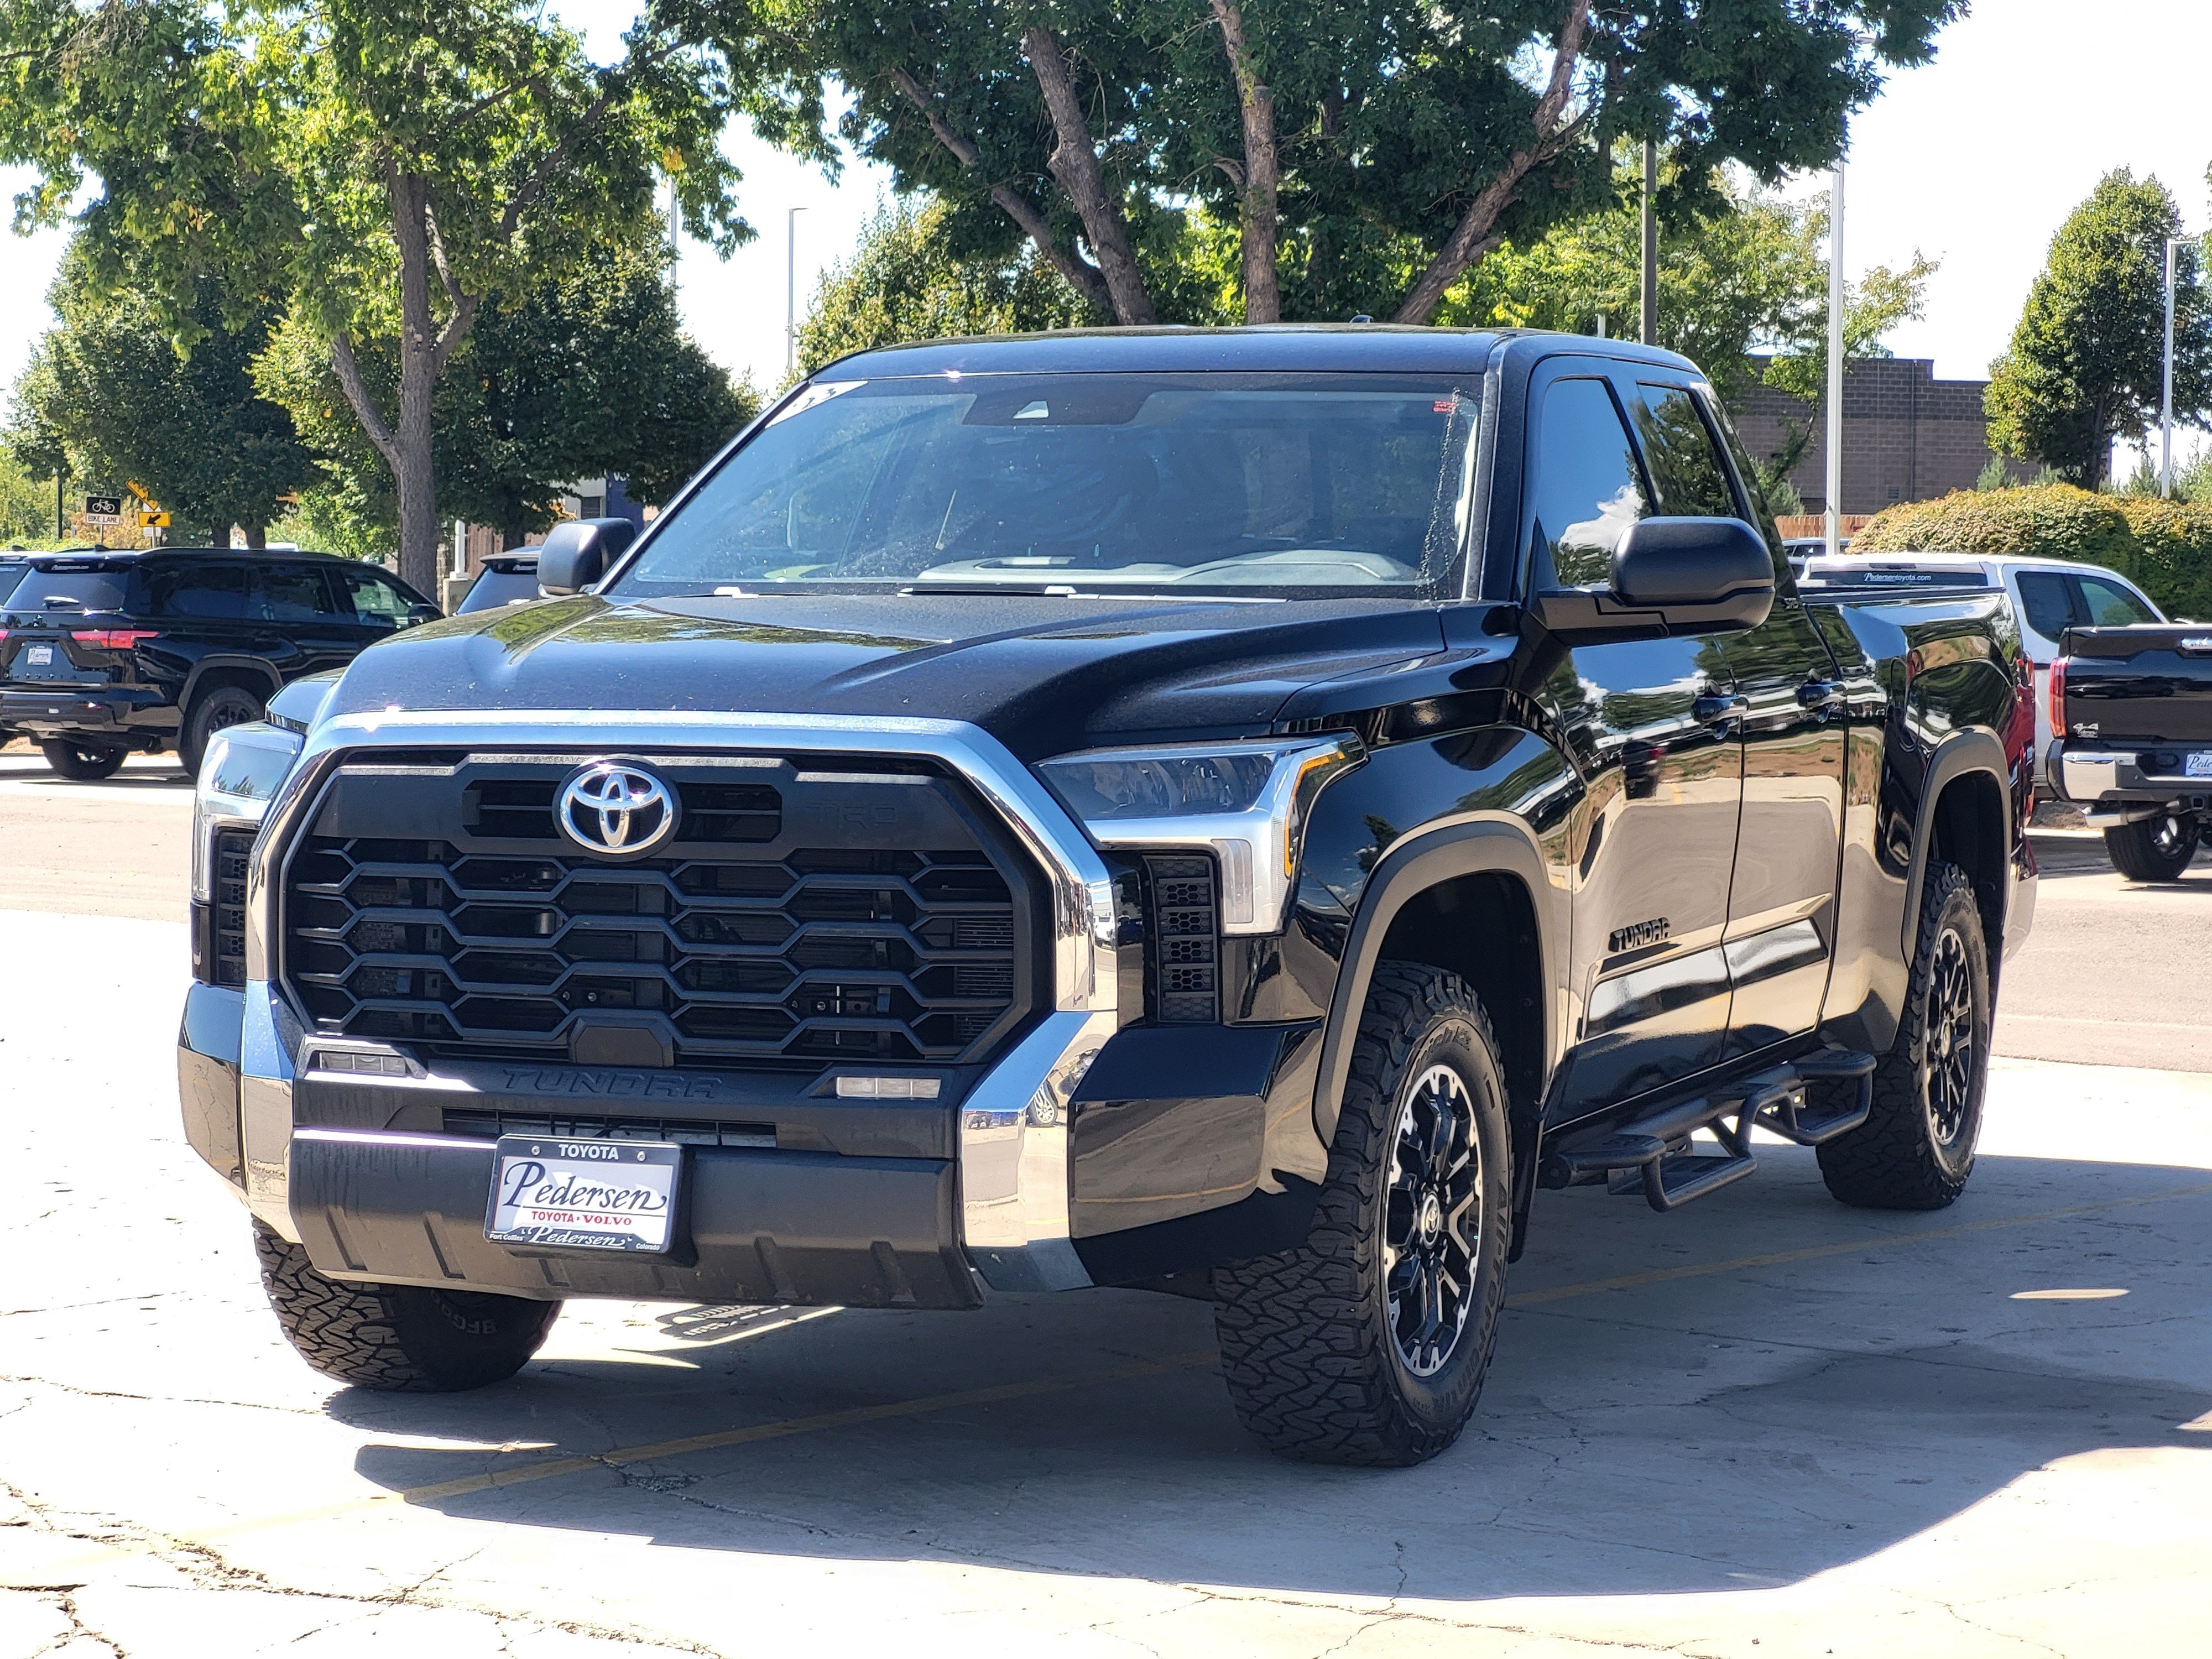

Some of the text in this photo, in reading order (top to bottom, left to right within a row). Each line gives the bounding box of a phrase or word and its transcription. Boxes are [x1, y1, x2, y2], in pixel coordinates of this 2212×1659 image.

[1608, 916, 1671, 952] TUNDRA
[503, 1068, 723, 1099] TUNDRA
[559, 1144, 619, 1160] TOYOTA
[501, 1161, 667, 1211] Pedersen
[531, 1211, 632, 1226] TOYOTA VOLVO
[503, 1233, 524, 1241] Collins
[528, 1225, 626, 1249] Pedersen
[635, 1243, 660, 1251] Colorado
